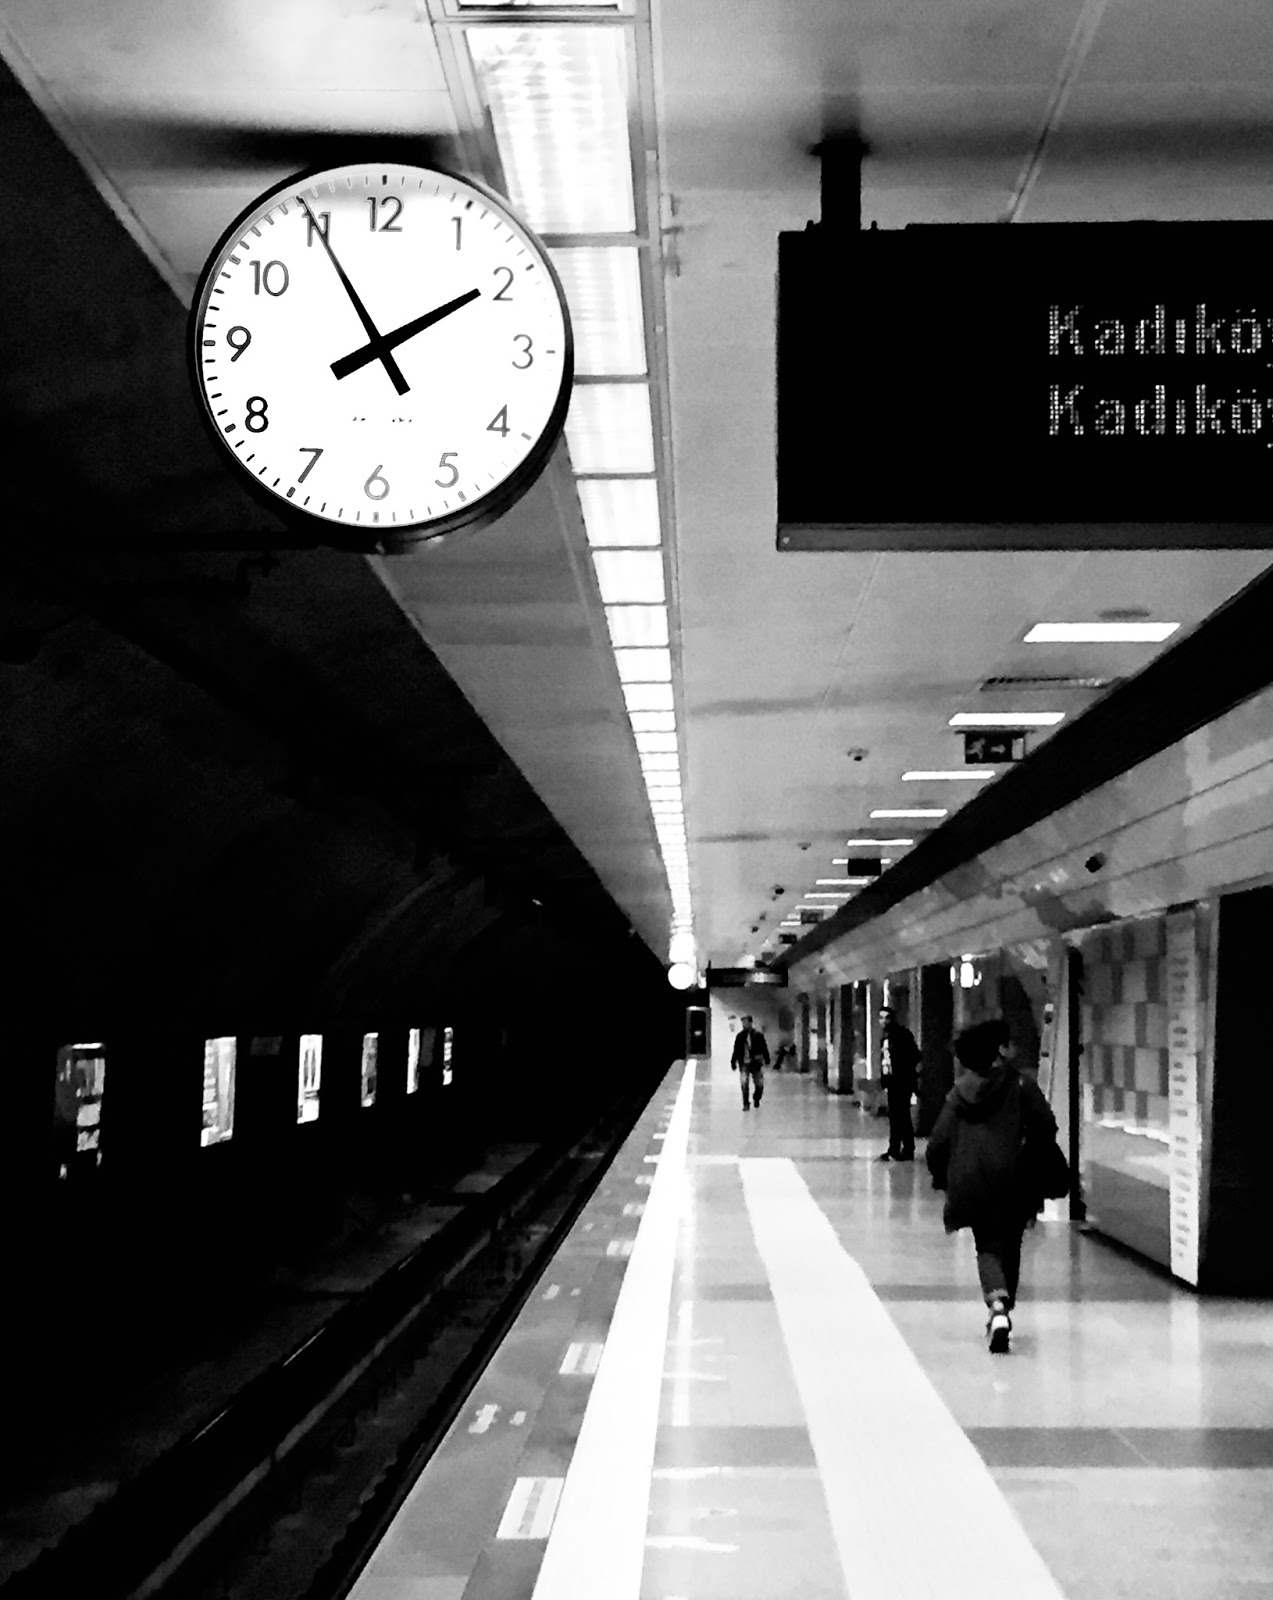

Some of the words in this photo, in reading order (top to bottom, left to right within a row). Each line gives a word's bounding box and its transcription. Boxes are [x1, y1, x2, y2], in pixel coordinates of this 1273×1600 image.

[302, 211, 332, 247] 11
[366, 196, 403, 232] 12
[451, 216, 463, 251] 1
[249, 260, 290, 297] 10
[492, 266, 515, 301] 2
[226, 326, 252, 362] 9
[511, 334, 534, 369] 3
[1049, 304, 1273, 368] Kadıkö
[244, 396, 269, 433] 8
[486, 404, 511, 437] 4
[1049, 384, 1273, 448] Kadıkö
[298, 448, 324, 483] 7
[363, 465, 390, 500] 6
[435, 452, 460, 488] 5
